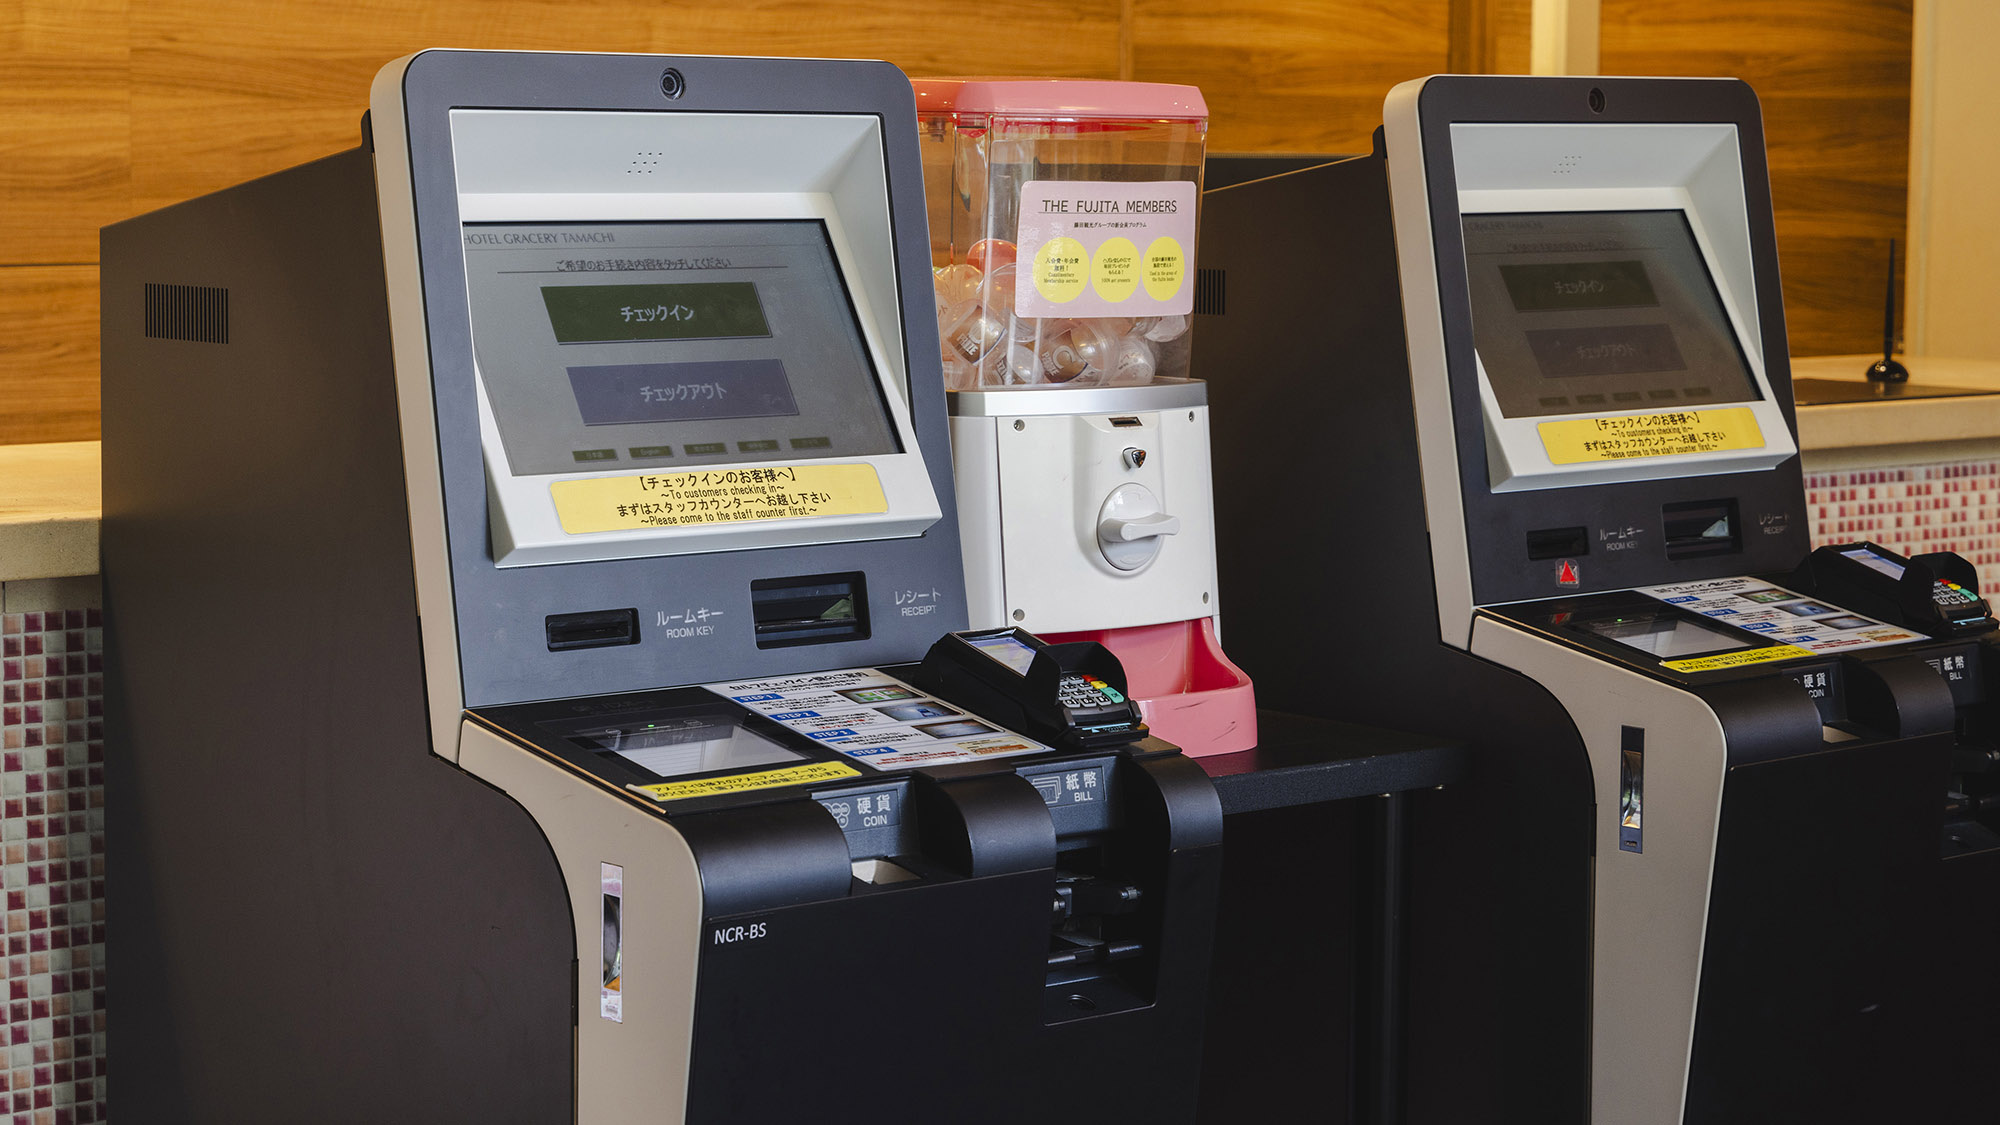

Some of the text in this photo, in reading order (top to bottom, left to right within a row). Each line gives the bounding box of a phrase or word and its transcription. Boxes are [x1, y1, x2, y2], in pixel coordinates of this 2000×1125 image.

[1042, 200, 1177, 213] THE FUJITA MEMBERS
[503, 233, 559, 245] GRACERY
[561, 232, 616, 244] TAMACHI
[620, 304, 695, 322] チェックイン
[639, 383, 727, 402] チェックアウト
[1595, 411, 1701, 431] 【チェックインのお客様へ】
[1627, 428, 1656, 438] customers
[1656, 426, 1681, 436] checking
[1583, 431, 1727, 451] まずはスタッフカウンターへお越し下さい
[1642, 448, 1649, 456] to
[639, 467, 797, 491] 【チェックインのお客様へ】
[684, 487, 728, 499] customers
[730, 484, 766, 496] checking
[616, 491, 832, 517] まずはスタッフカウンターへお越し下さい
[680, 515, 703, 524] come
[705, 512, 714, 522] to
[717, 511, 730, 521] the
[732, 509, 754, 520] staff
[755, 509, 786, 519] counter
[1599, 526, 1644, 541] ルームキー
[1606, 542, 1626, 551] ROOM
[894, 587, 941, 605] レシート
[656, 608, 724, 627] ルームキー
[900, 605, 937, 617] RECEIPT
[666, 625, 715, 639] ROOM KEY
[1803, 672, 1826, 688] 硬貨
[1949, 671, 1962, 681] BILL
[1065, 771, 1097, 791] 紙幣
[856, 794, 891, 815] 硬貨
[1074, 792, 1093, 802] BILL
[863, 815, 888, 827] COIN
[714, 922, 767, 945] NCR-BS
